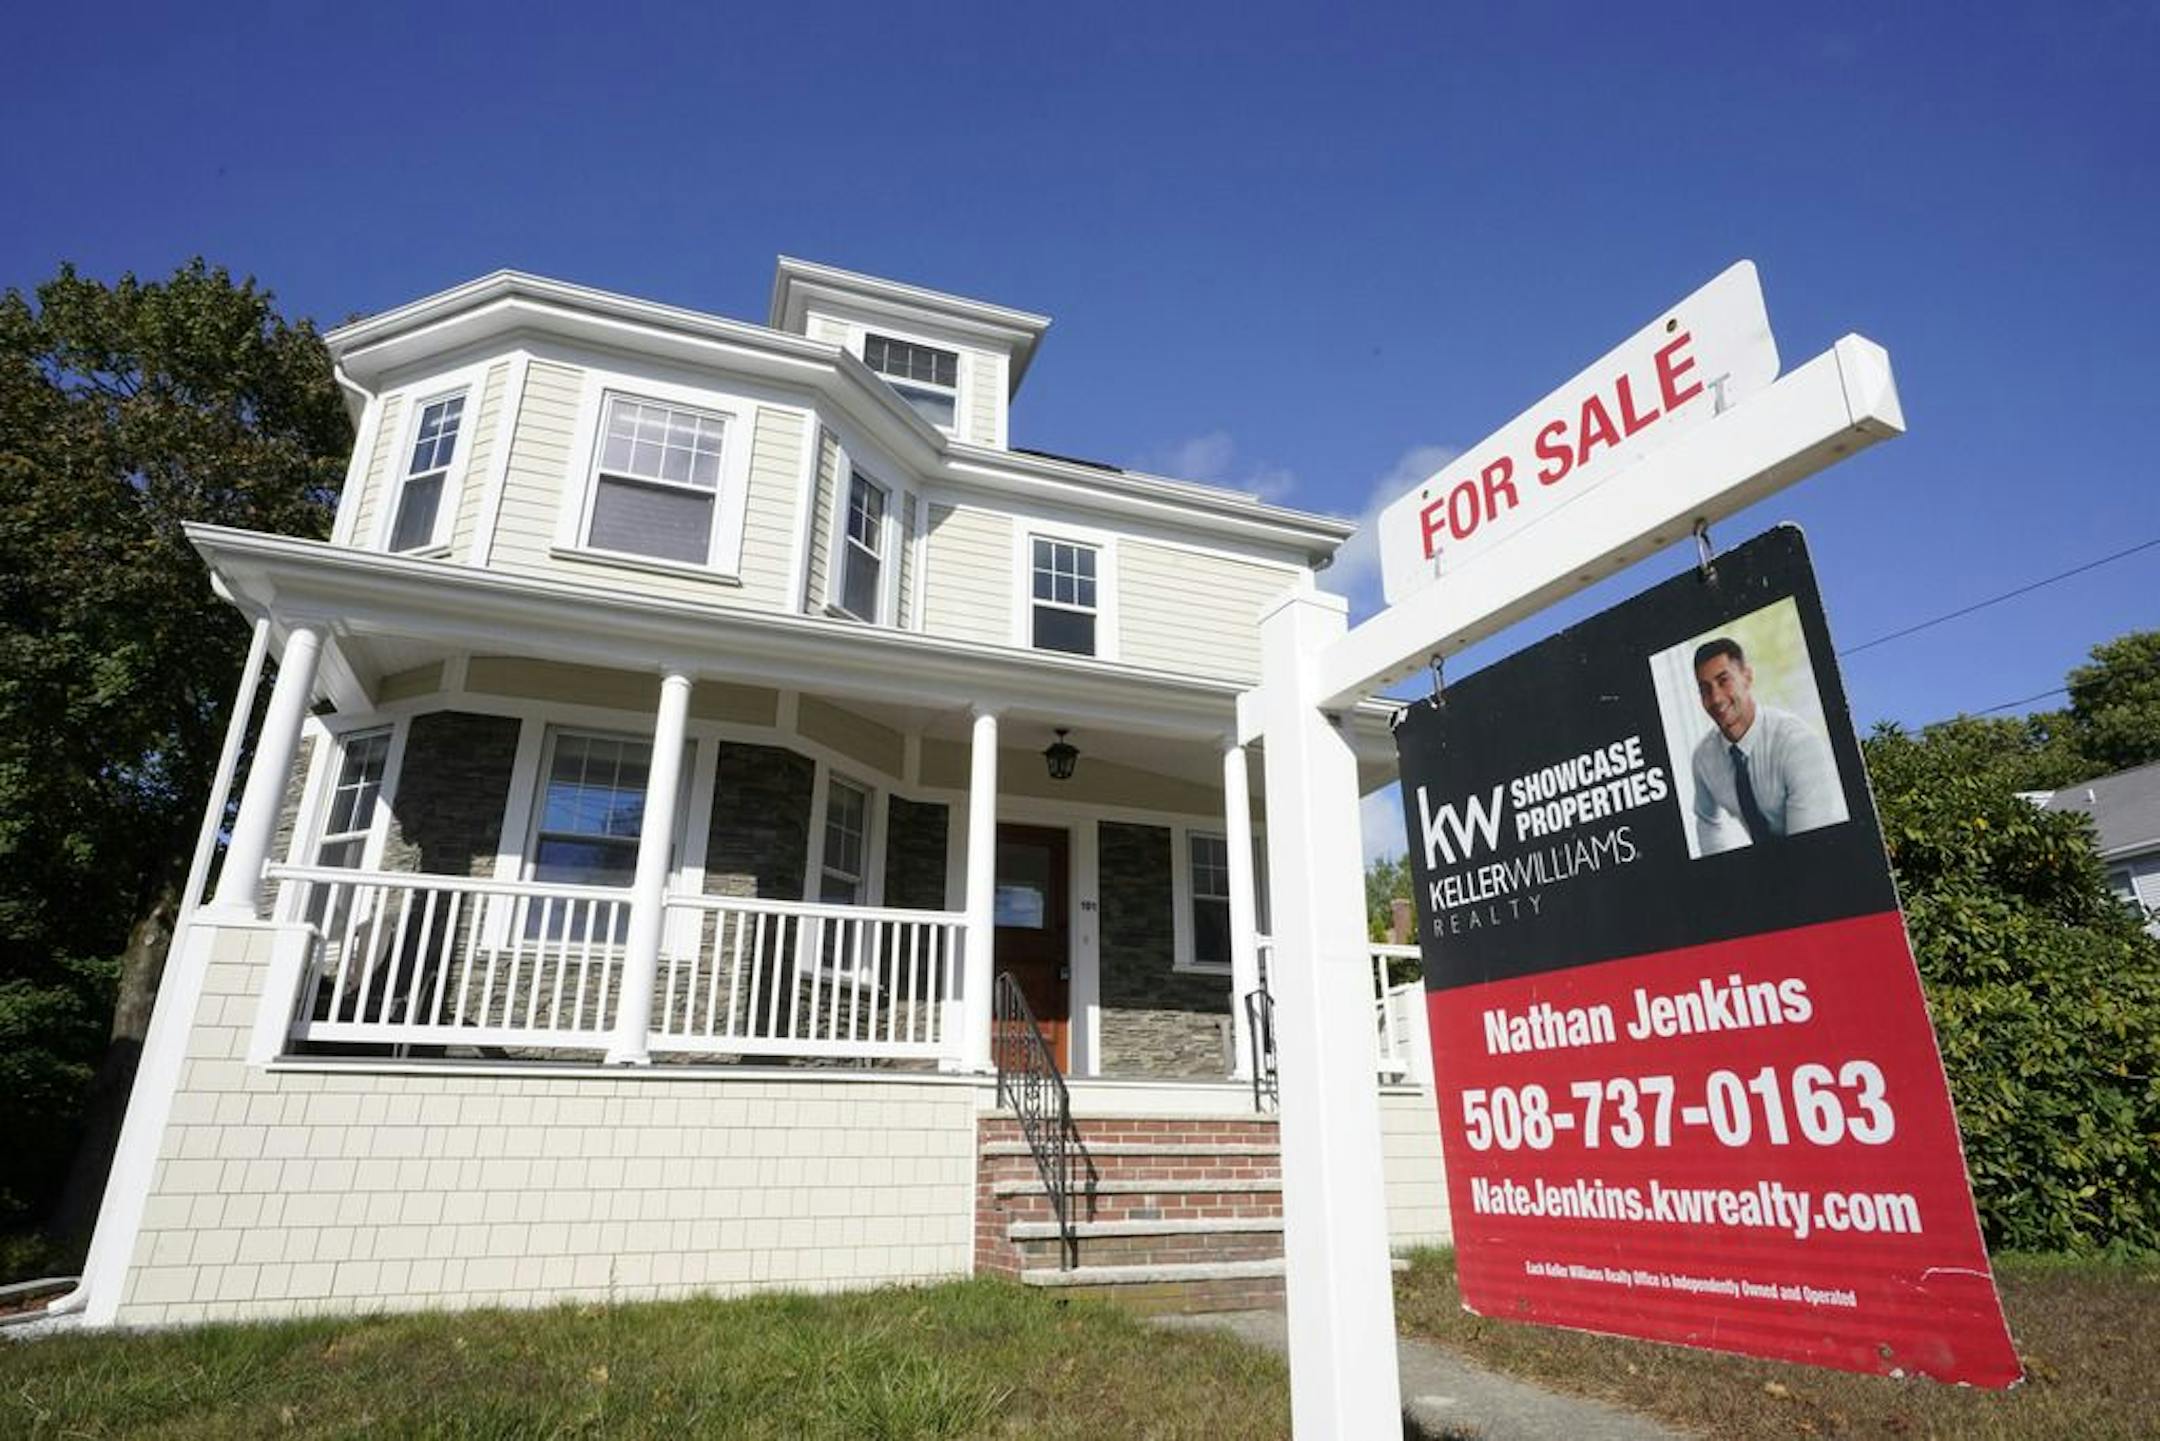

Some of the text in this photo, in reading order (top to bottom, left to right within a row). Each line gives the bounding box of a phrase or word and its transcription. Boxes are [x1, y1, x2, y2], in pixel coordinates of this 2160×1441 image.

[1419, 331, 1704, 560] FOR SALE
[1510, 735, 1645, 809] SHOWCASE
[1515, 766, 1668, 842] PROPERTIES
[1433, 894, 1542, 937] REALTY
[1483, 973, 1814, 1054] Nathan Jenkins
[1462, 1060, 1896, 1152] 508-737-0163
[1470, 1177, 1923, 1239] NateJenkins.kwrealty.com
[1604, 1267, 1632, 1288] Realty
[1633, 1269, 1660, 1287] Office
[1660, 1272, 1671, 1289] is
[1671, 1273, 1740, 1298] Independently
[1741, 1279, 1779, 1300] Owned
[1779, 1284, 1802, 1301] and
[1802, 1285, 1857, 1307] Operated
